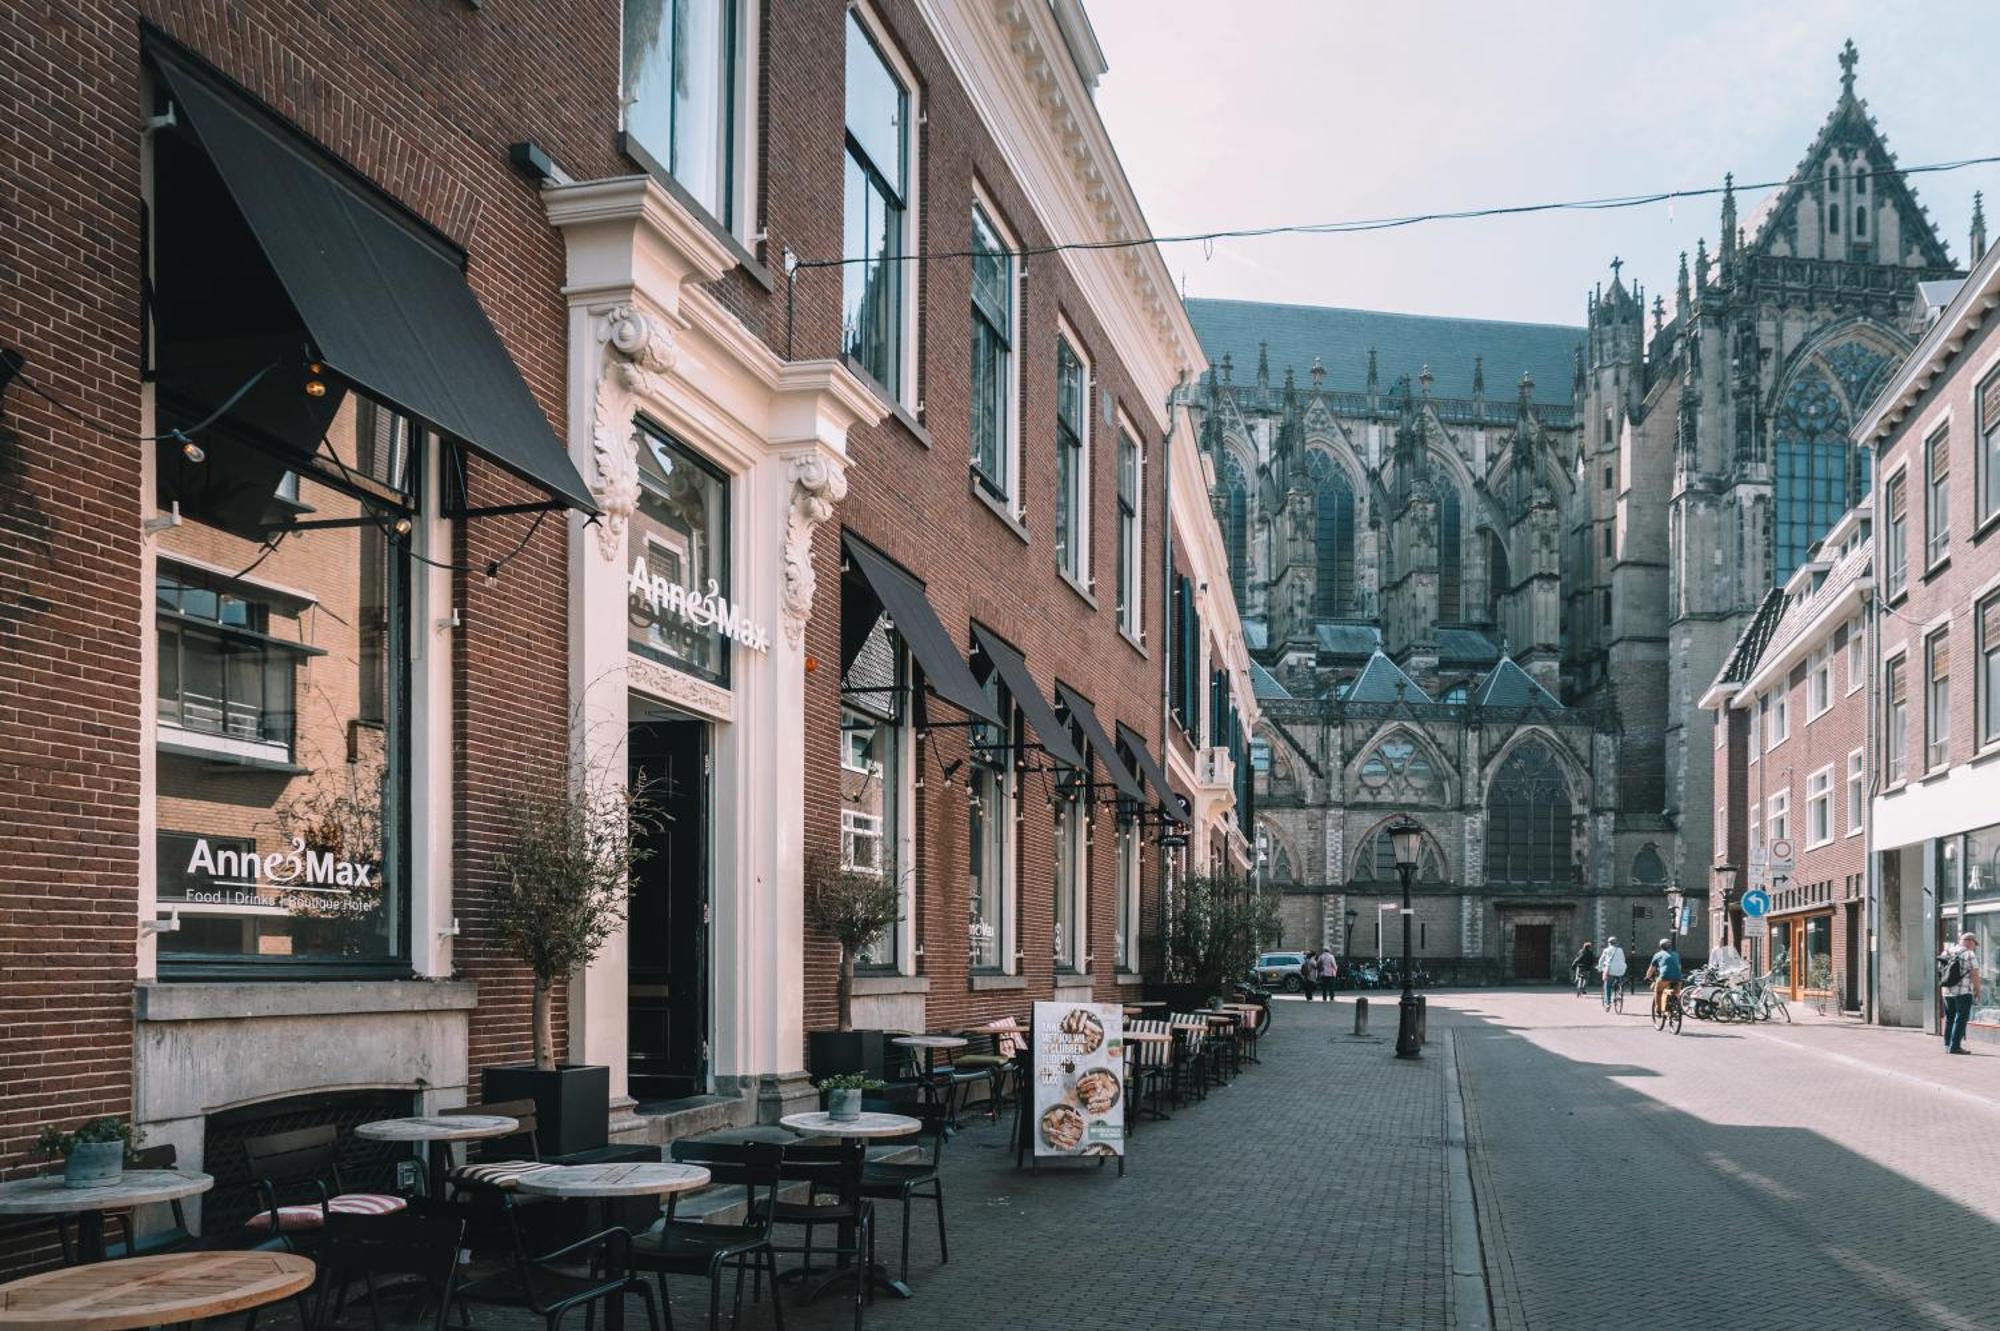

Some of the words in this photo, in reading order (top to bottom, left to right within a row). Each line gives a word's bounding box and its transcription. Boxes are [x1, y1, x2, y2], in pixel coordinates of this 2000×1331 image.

[186, 889, 221, 904] Food
[235, 891, 276, 906] Drinks
[289, 896, 340, 912] Boutique
[343, 899, 373, 912] Hotel
